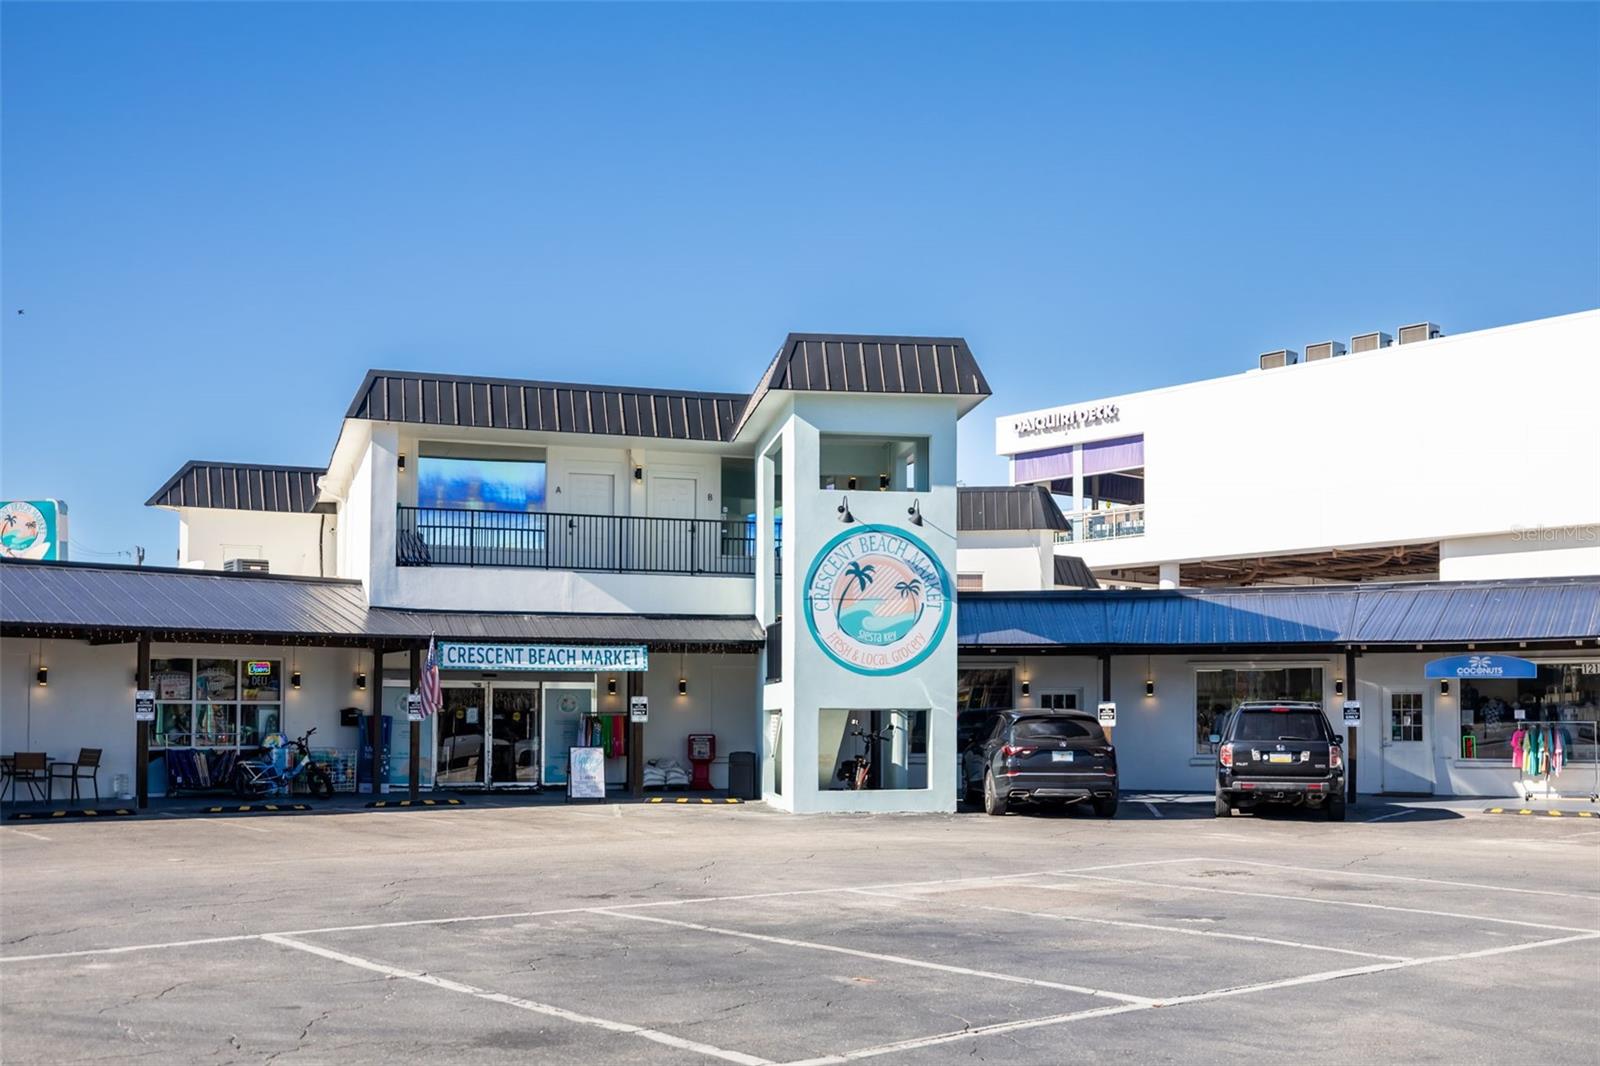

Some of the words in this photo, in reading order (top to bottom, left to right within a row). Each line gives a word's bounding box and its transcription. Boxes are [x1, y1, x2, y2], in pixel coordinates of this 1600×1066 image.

[1014, 410, 1079, 434] DAIQUIRI
[555, 486, 562, 494] A
[707, 493, 713, 502] B
[814, 542, 855, 611] CRESCENT
[859, 535, 908, 558] BEACH
[906, 551, 943, 612] MARKET
[447, 646, 525, 664] CRESCENT
[528, 648, 577, 665] BEACH
[581, 648, 640, 666] MARKET
[252, 676, 268, 685] DELI
